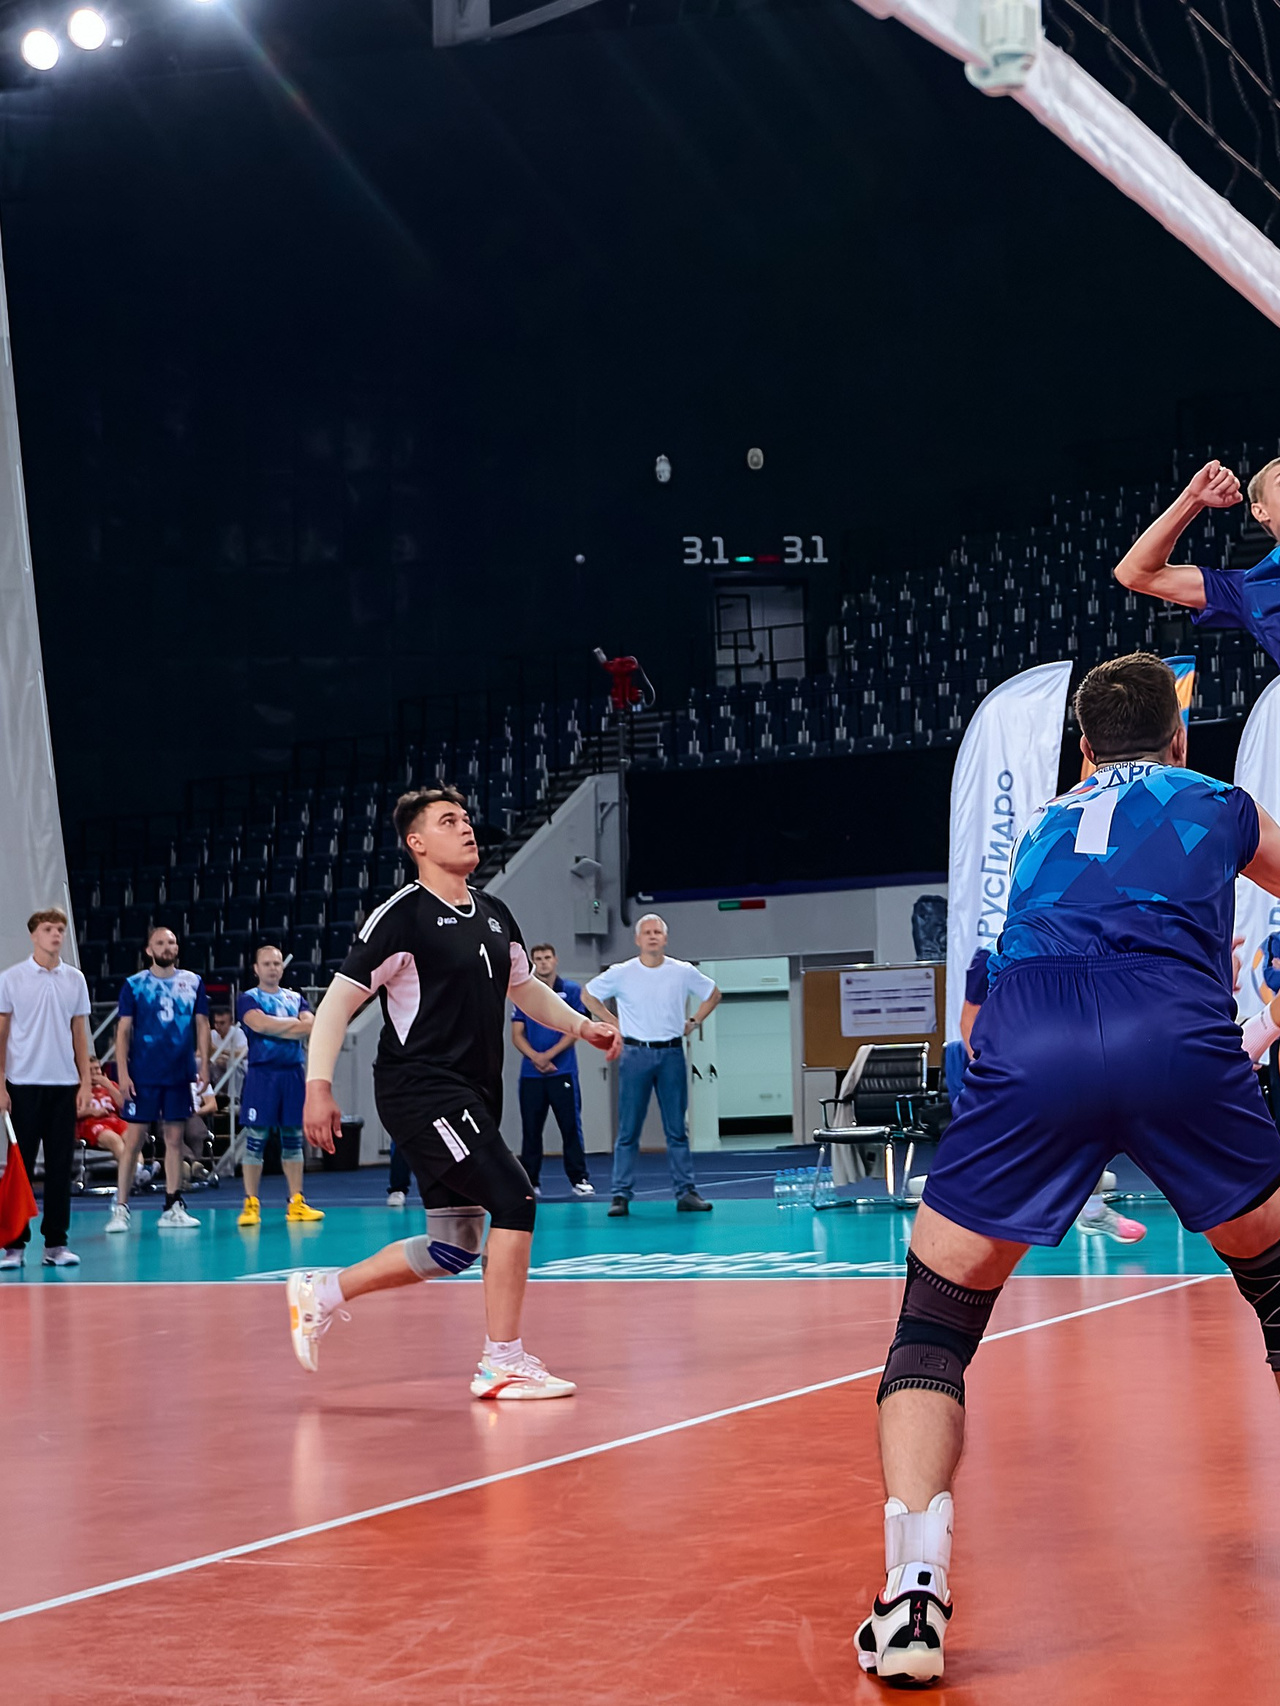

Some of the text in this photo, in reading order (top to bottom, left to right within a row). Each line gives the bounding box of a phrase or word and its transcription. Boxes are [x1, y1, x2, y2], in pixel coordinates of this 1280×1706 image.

[676, 535, 829, 565] 3.1 3.1
[1066, 787, 1119, 855] 1
[479, 943, 493, 979] 1
[158, 997, 175, 1022] 3
[128, 1102, 137, 1116] 3
[248, 1107, 257, 1122] 9
[461, 1108, 480, 1134] 1
